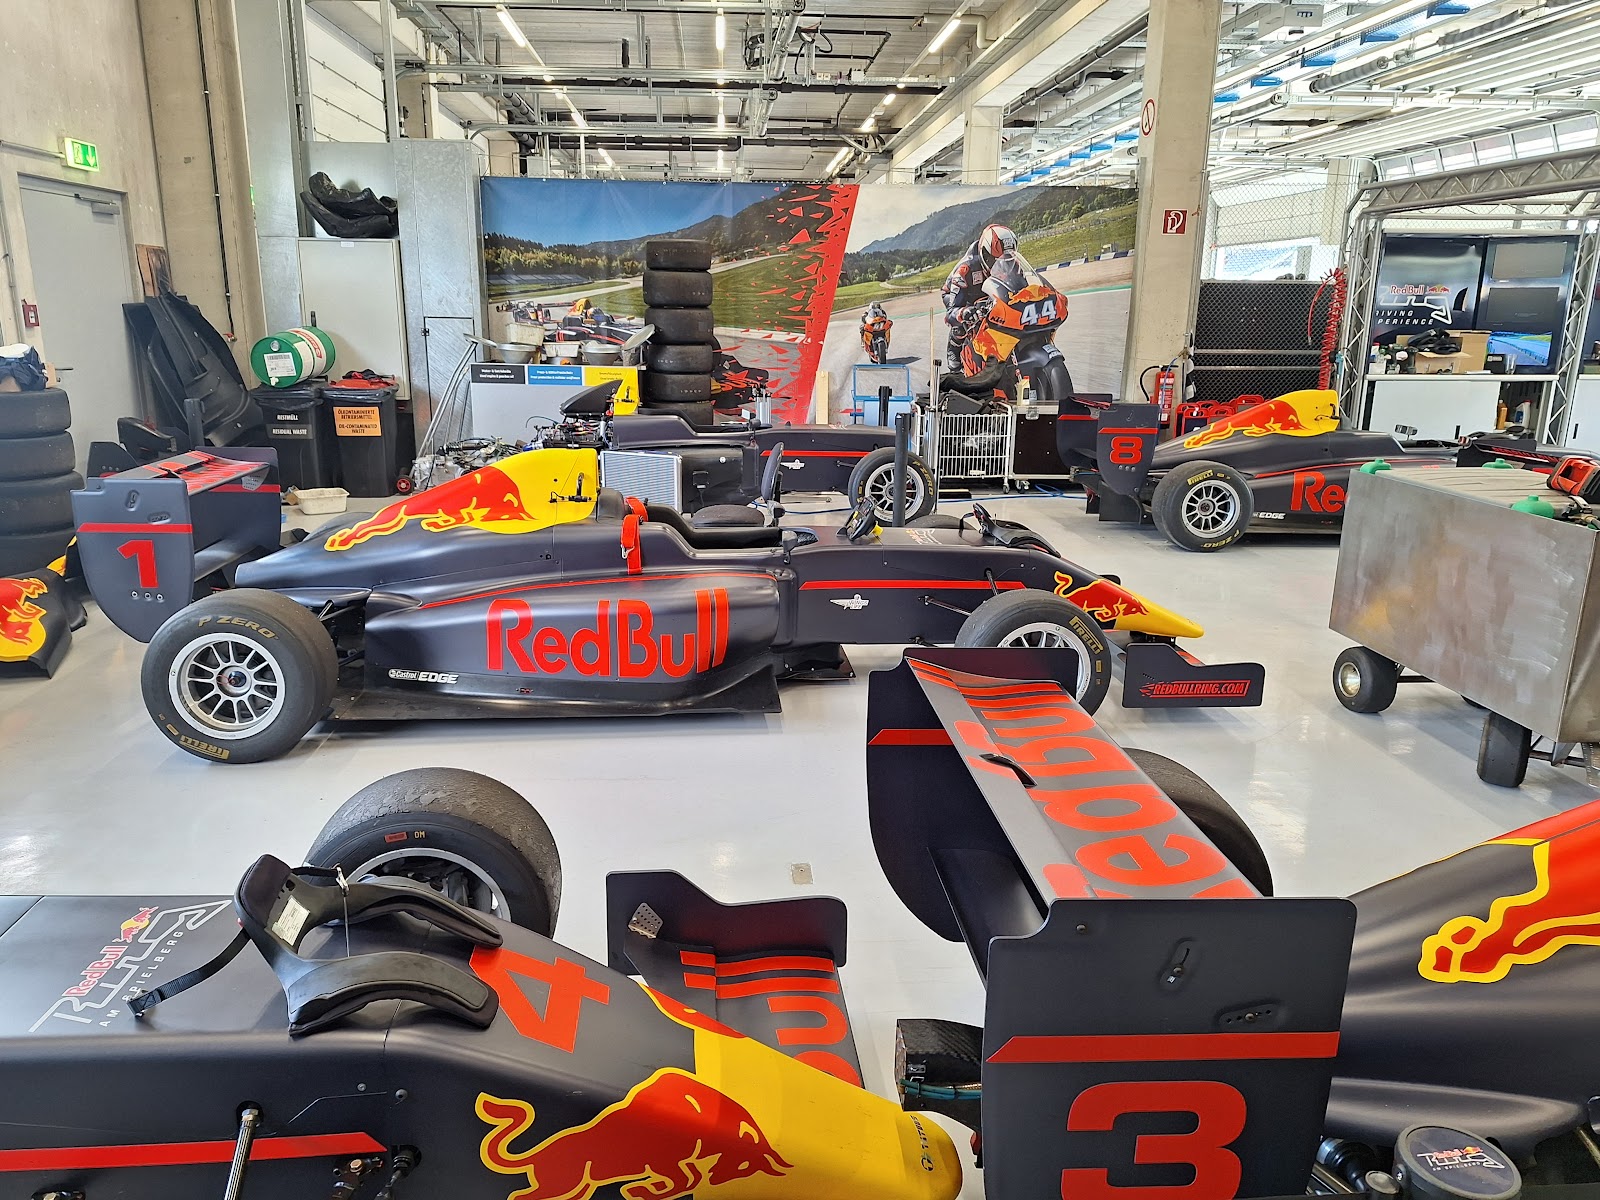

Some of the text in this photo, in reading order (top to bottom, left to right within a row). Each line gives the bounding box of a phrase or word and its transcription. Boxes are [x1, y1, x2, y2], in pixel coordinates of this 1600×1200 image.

[1021, 300, 1057, 326] 44
[1110, 436, 1143, 464] 8
[1186, 469, 1214, 486] PIRELLI
[1259, 512, 1286, 520] EDGE
[117, 540, 159, 588] 1
[198, 615, 276, 639] P ZERO
[1068, 615, 1104, 655] PIRELLI
[396, 670, 460, 684] Castrol EDGE
[1153, 682, 1245, 695] REDBULLRING.COM
[179, 734, 230, 760] PIRELLI
[122, 930, 184, 1002] SPIELBERG
[469, 944, 610, 1054] 4
[99, 1009, 121, 1028] AM
[1061, 1081, 1247, 1200] 3
